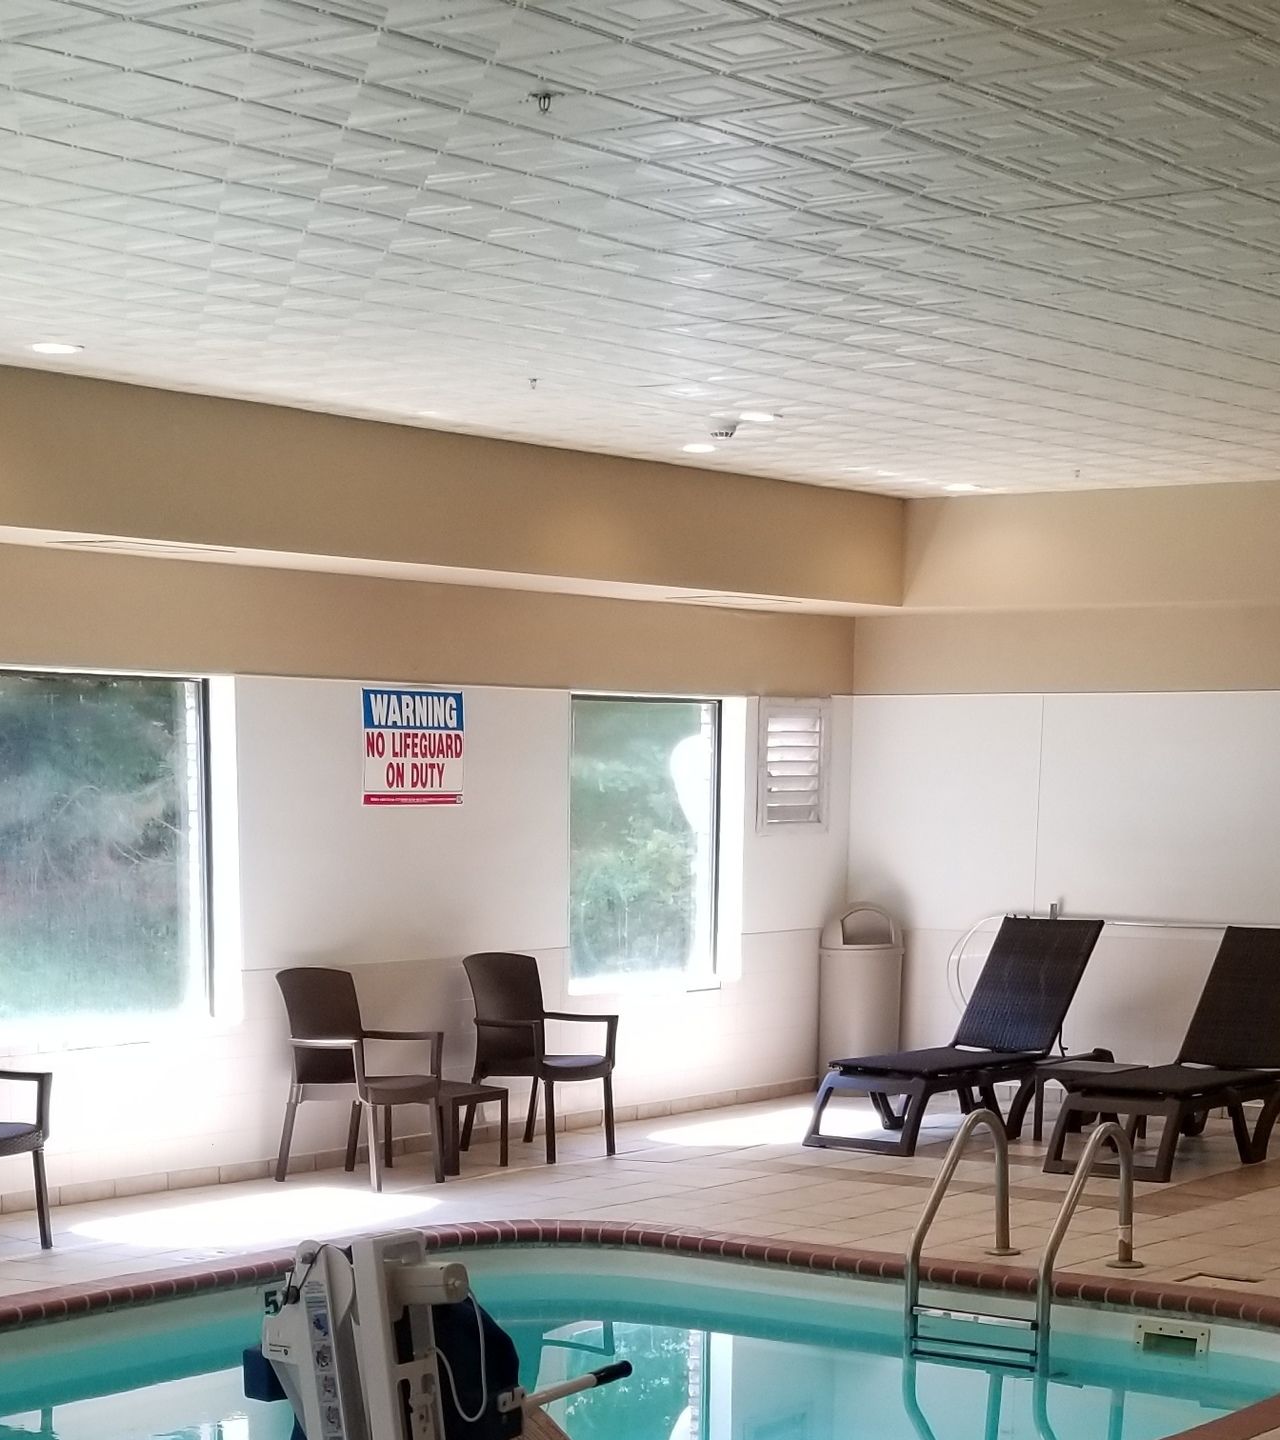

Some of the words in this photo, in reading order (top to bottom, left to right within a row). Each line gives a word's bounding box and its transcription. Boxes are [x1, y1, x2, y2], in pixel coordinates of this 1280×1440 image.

[369, 693, 458, 728] WARNING
[366, 731, 386, 758] NO
[391, 732, 463, 759] LIFEGUARD
[385, 761, 405, 789] ON
[410, 762, 445, 789] DUTY
[264, 1290, 280, 1315] 5
